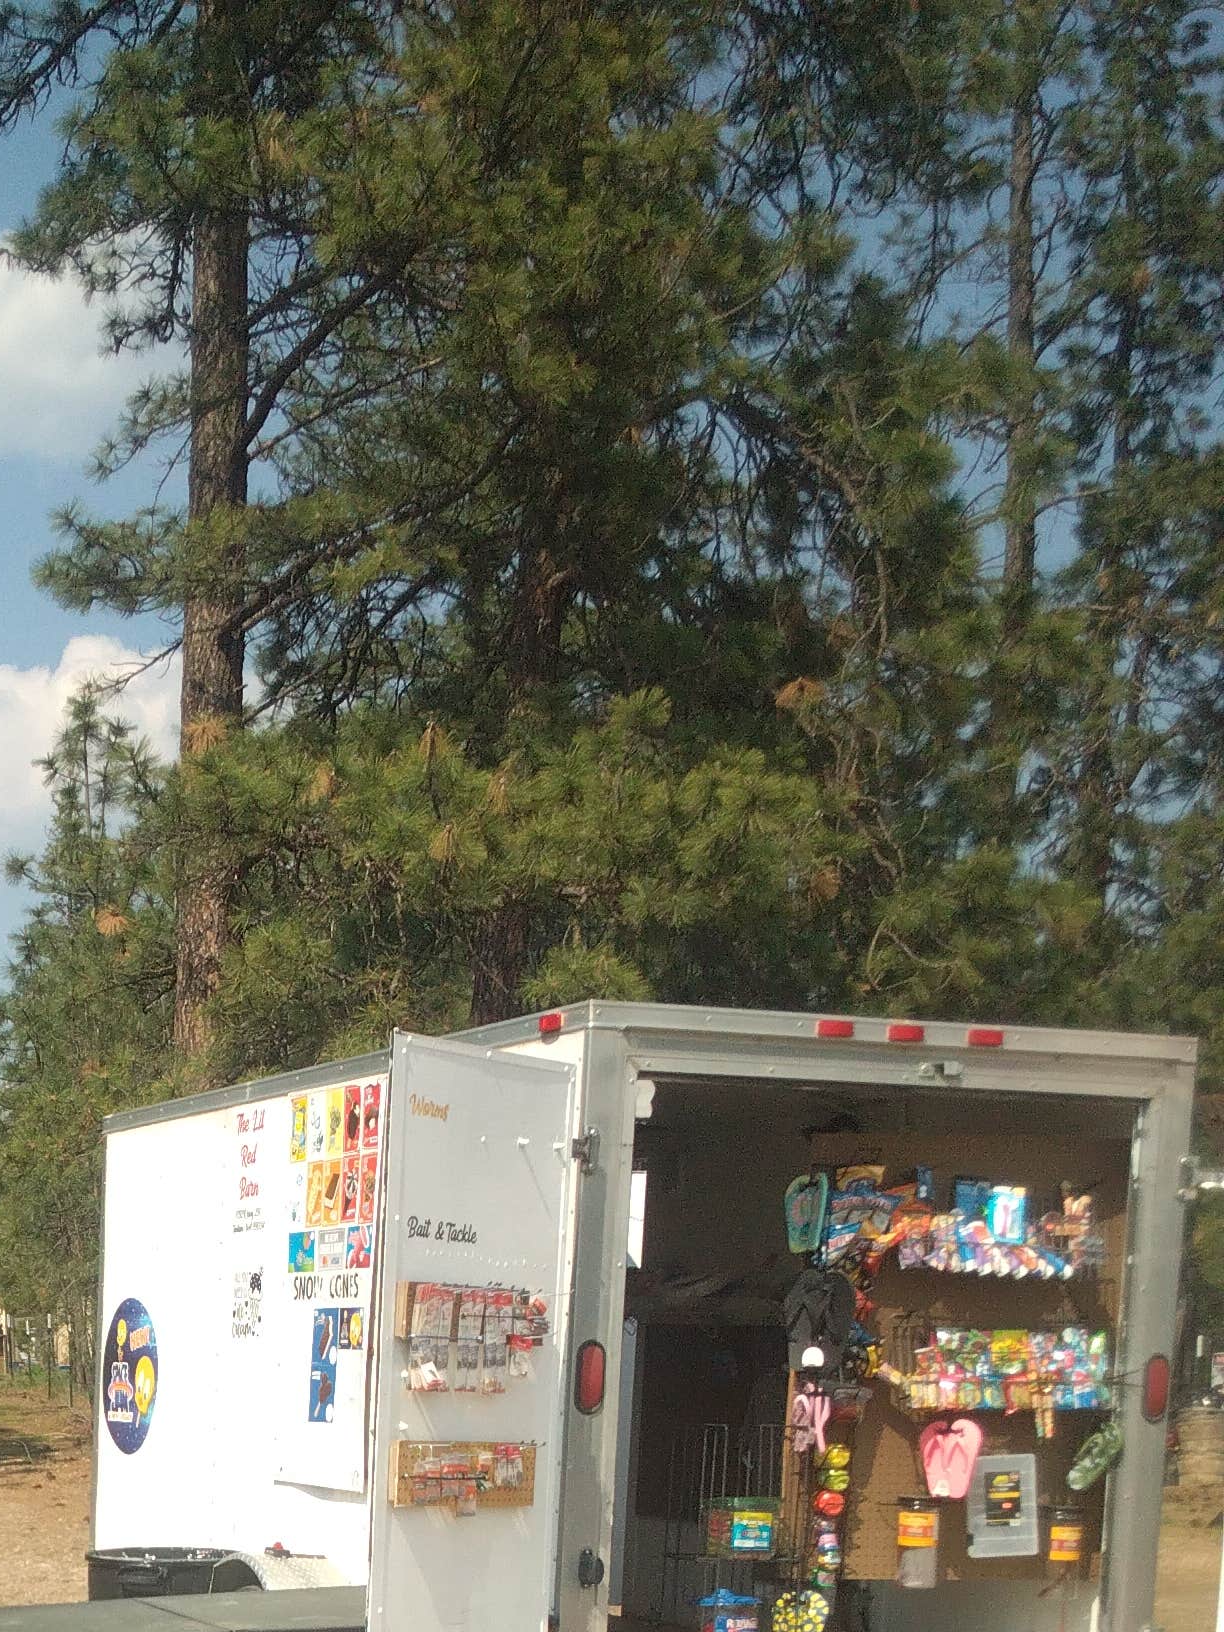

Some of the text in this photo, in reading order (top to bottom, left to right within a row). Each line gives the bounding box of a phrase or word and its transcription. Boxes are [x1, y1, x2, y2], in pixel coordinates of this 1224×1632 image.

[409, 1093, 450, 1122] Worms
[237, 1113, 250, 1136] The
[241, 1142, 257, 1168] Red
[239, 1176, 259, 1200] Barn
[407, 1215, 478, 1245] Bait & Tackle
[329, 1272, 359, 1299] CONES
